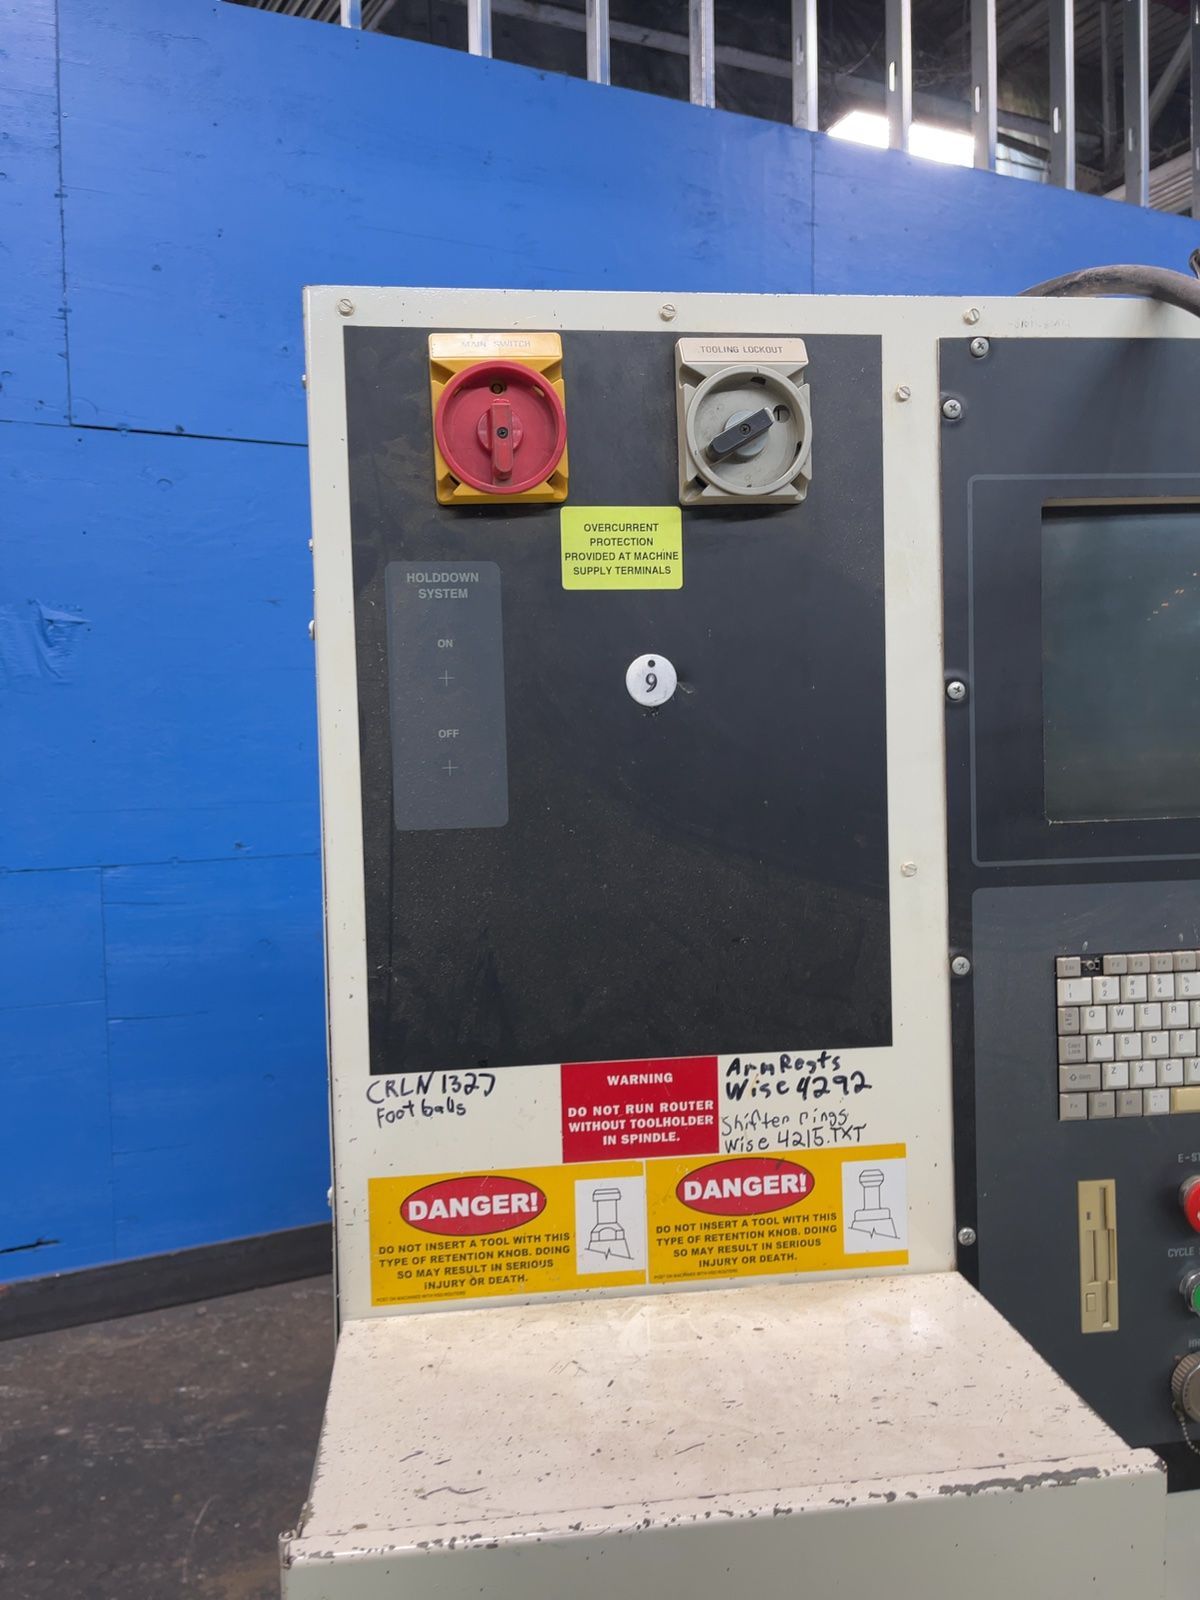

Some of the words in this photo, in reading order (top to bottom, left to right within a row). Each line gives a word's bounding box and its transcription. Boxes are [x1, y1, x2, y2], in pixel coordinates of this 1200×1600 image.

[462, 340, 487, 348] MAIN
[493, 340, 531, 348] SWITCH
[700, 346, 740, 354] TOOLING
[743, 346, 784, 354] LOCKOUT
[584, 523, 659, 532] OVERCURRENT
[590, 538, 654, 546] PROTECTION
[564, 552, 616, 561] PROVIDED
[618, 552, 631, 560] AT
[634, 551, 680, 560] MACHINE
[406, 572, 479, 584] HOLDDOWN
[573, 566, 612, 576] SUPPLY
[614, 566, 672, 575] TERMINALS
[418, 588, 468, 599] SYSTEM
[437, 639, 454, 648] ON
[645, 672, 658, 693] 9
[438, 729, 460, 739] OFF
[1088, 1010, 1096, 1018] Q
[1178, 1034, 1184, 1042] F
[1111, 1066, 1116, 1074] Z
[1166, 1063, 1172, 1071] C
[606, 1072, 674, 1086] WARNING
[796, 1071, 872, 1100] 4292
[366, 1071, 436, 1104] CRLN
[442, 1072, 496, 1097] 1327
[568, 1106, 588, 1118] DO
[592, 1105, 620, 1116] NOT
[625, 1103, 654, 1114] RUN
[659, 1100, 714, 1113] ROUTER
[568, 1120, 626, 1132] WITHOUT
[630, 1114, 714, 1129] TOOLHOLDER
[602, 1135, 616, 1146] IN
[620, 1132, 680, 1144] SPINDLE.
[725, 1136, 770, 1154] Wise
[778, 1123, 867, 1148] 4215.TXT
[684, 1173, 808, 1201] DANGER!
[408, 1192, 538, 1222] DANGER!
[656, 1225, 671, 1234] DO
[674, 1223, 696, 1232] NOT
[700, 1220, 738, 1231] INSERT
[741, 1219, 748, 1228] A
[752, 1216, 780, 1226] TOOL
[782, 1214, 810, 1224] WITH
[812, 1212, 837, 1222] THIS
[378, 1246, 394, 1254] DO
[398, 1244, 422, 1253] NOT
[426, 1240, 466, 1251] INSERT
[470, 1239, 477, 1248] A
[480, 1236, 509, 1248] TOOL
[513, 1234, 541, 1244] WITH
[544, 1232, 570, 1242] THIS
[656, 1237, 684, 1246] TYPE
[687, 1235, 701, 1244] OF
[704, 1230, 764, 1242] RETENTION
[768, 1228, 800, 1237] KNOB.
[804, 1225, 837, 1234] DOING
[673, 1248, 688, 1258] SO
[691, 1246, 714, 1256] MAY
[718, 1243, 758, 1254] RESULT
[762, 1242, 773, 1250] IN
[776, 1238, 822, 1249] SERIOUS
[1168, 1246, 1194, 1258] CYCLE
[379, 1258, 408, 1268] TYPE
[412, 1256, 426, 1265] OF
[430, 1250, 494, 1264] RETENTION
[497, 1248, 532, 1258] KNOB.
[536, 1246, 570, 1256] DOING
[698, 1258, 737, 1268] INJURY
[742, 1255, 756, 1264] OR
[759, 1252, 798, 1263] DEATH.
[397, 1270, 412, 1280] SO
[416, 1267, 440, 1278] MAY
[444, 1264, 488, 1276] RESULT
[490, 1263, 502, 1272] IN
[506, 1259, 554, 1270] SERIOUS
[424, 1279, 466, 1290] INJURY
[469, 1276, 484, 1286] OR
[488, 1274, 528, 1284] DEATH.
